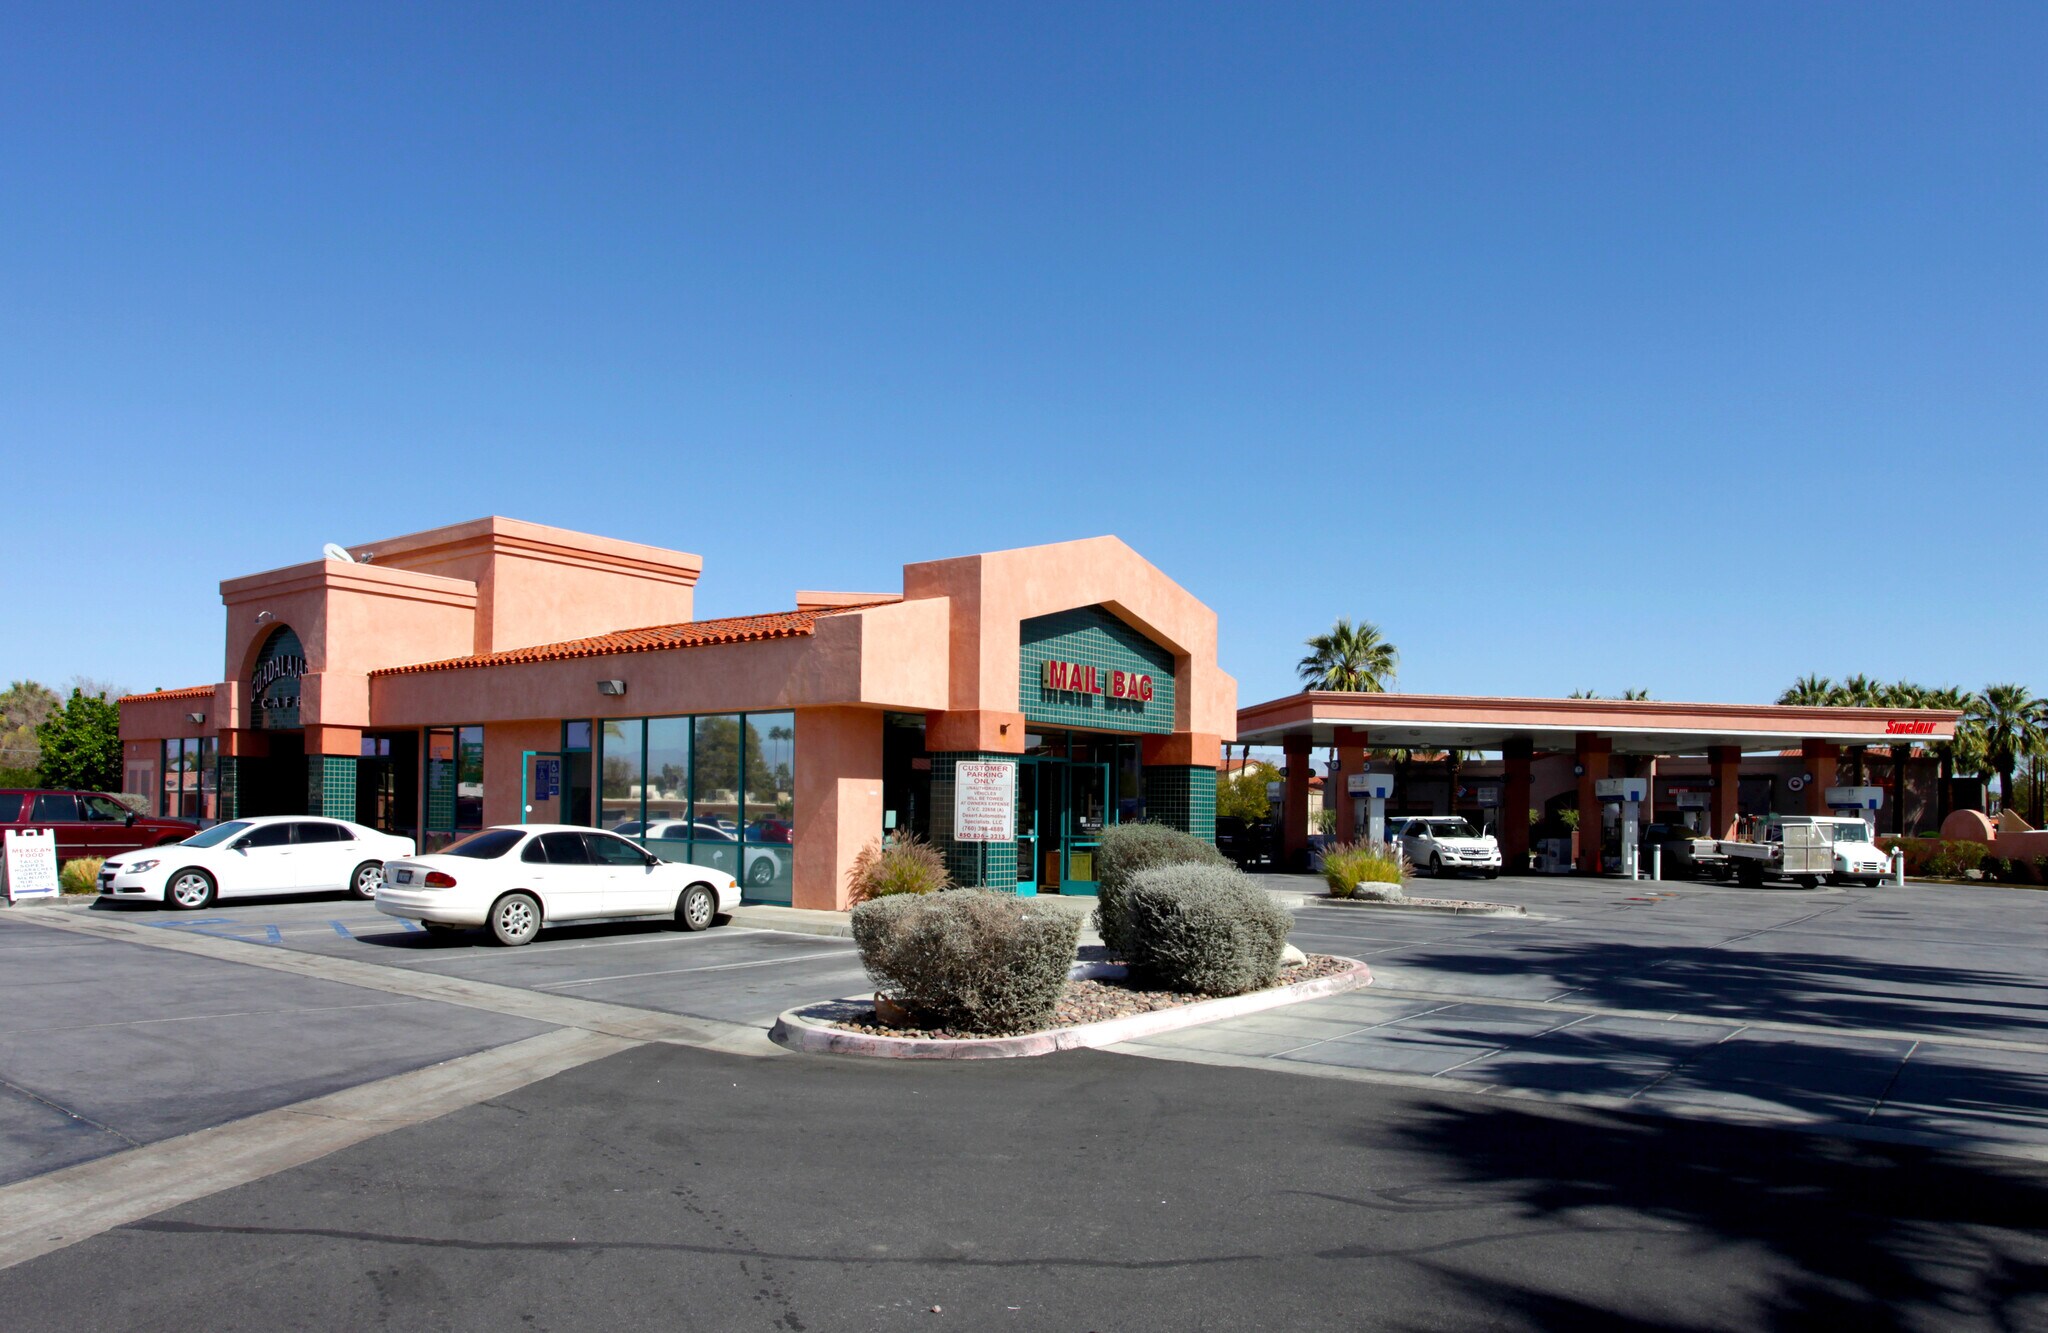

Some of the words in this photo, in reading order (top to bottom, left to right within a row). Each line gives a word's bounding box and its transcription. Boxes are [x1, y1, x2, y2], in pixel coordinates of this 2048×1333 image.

[1047, 660, 1102, 695] MAIL
[1110, 670, 1154, 702] BAG
[262, 696, 301, 709] CAFE
[1885, 719, 1936, 734] Sinclair
